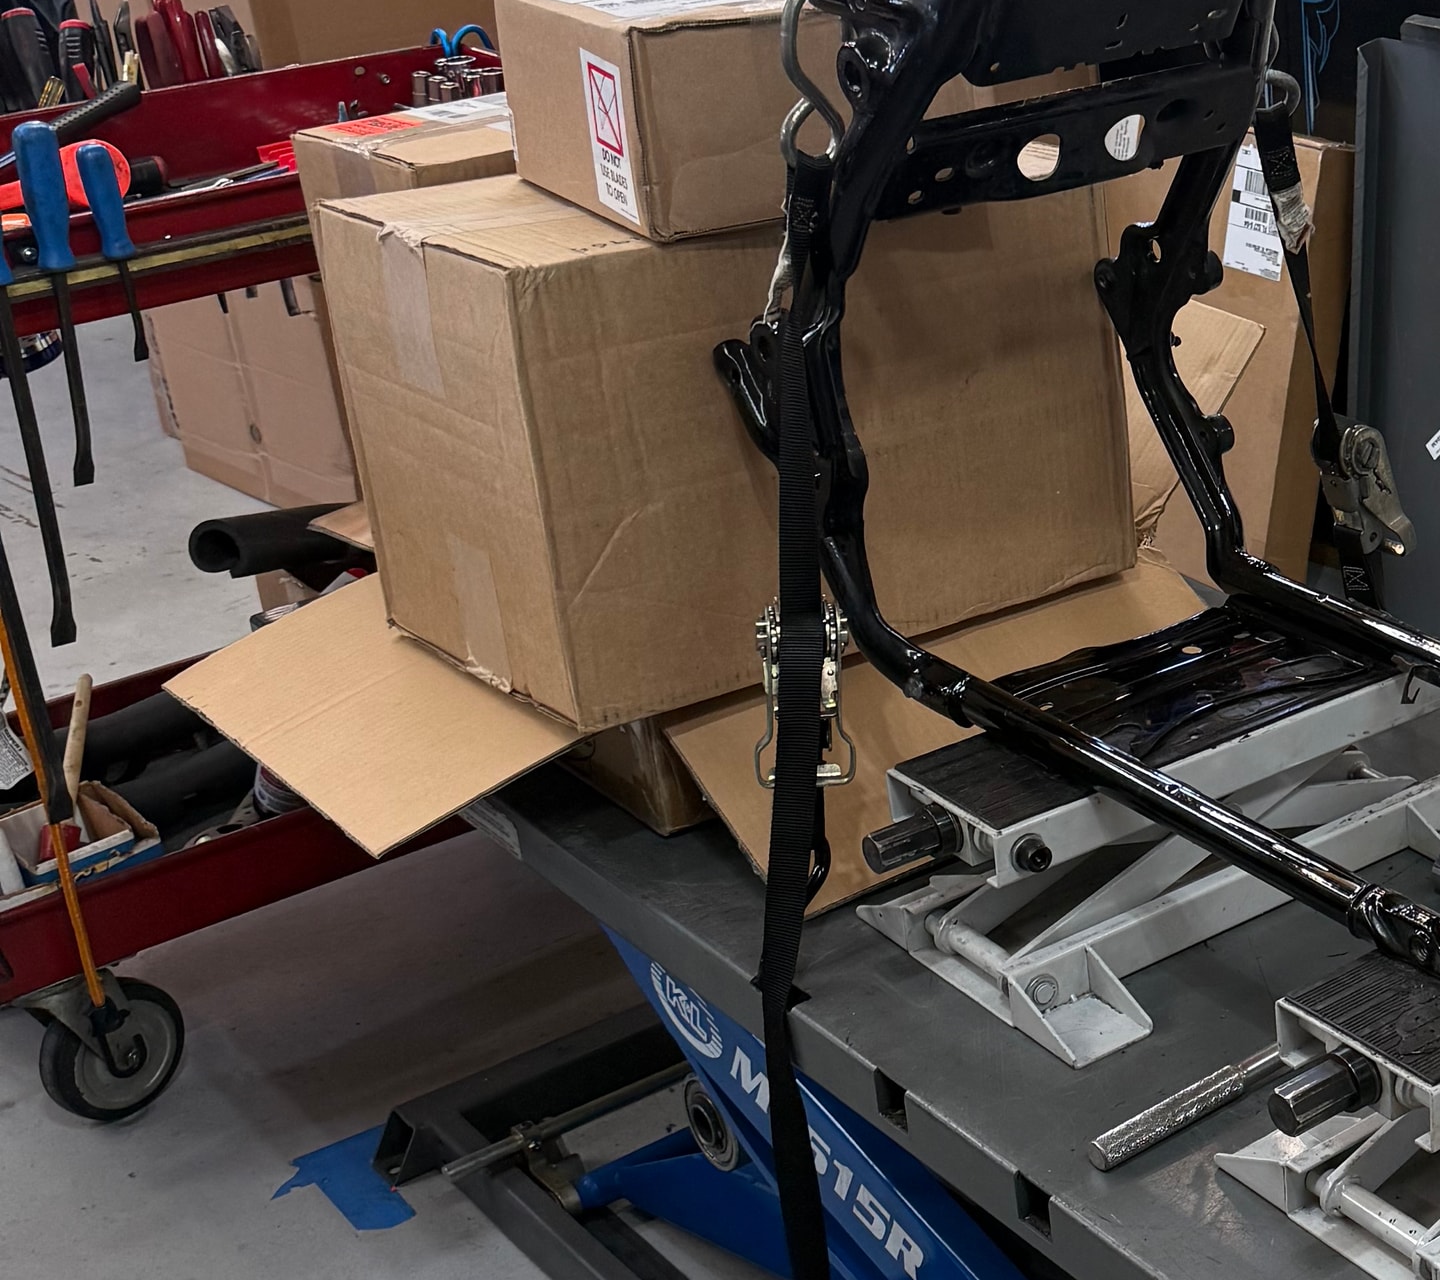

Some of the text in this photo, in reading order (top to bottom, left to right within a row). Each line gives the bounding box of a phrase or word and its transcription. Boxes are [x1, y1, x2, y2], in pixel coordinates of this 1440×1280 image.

[602, 148, 621, 170] DO NOT
[614, 188, 628, 207] OPEN
